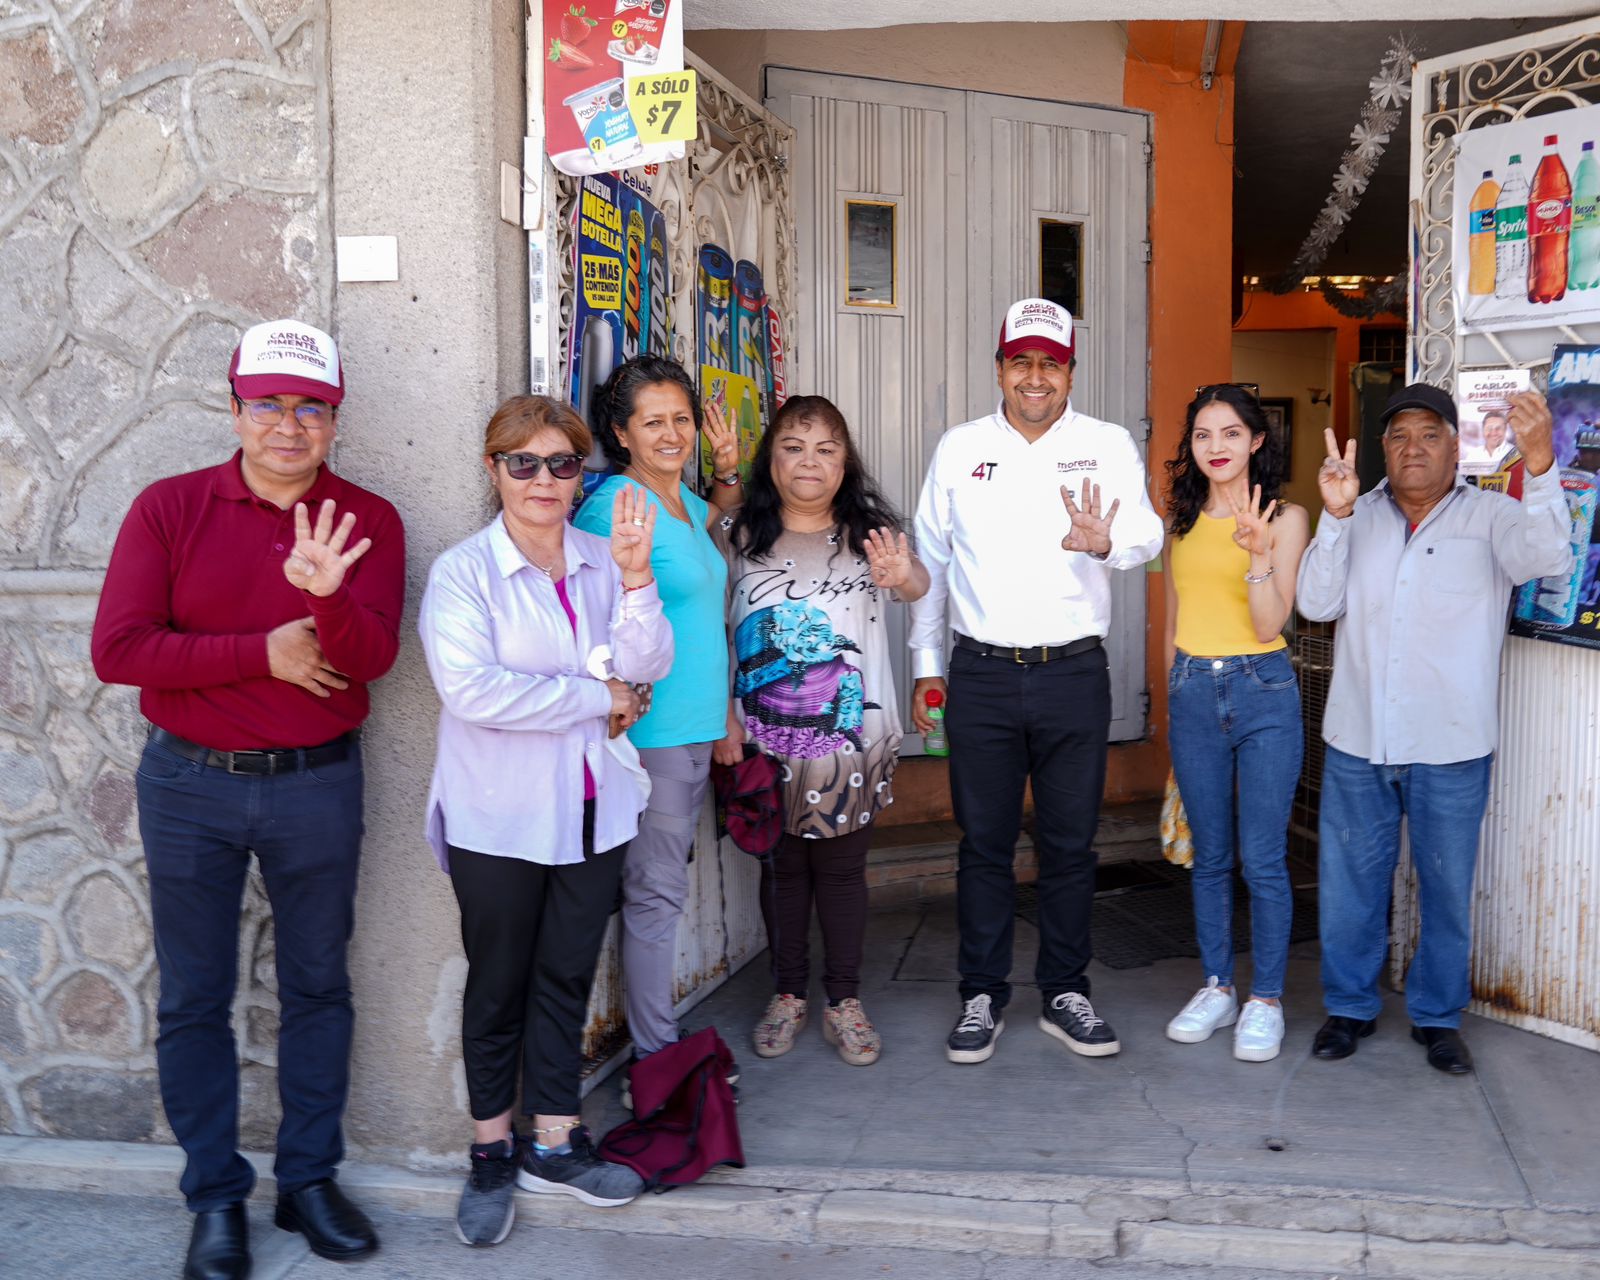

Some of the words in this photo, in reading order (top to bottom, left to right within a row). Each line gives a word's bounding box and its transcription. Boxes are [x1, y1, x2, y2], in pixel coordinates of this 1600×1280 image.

[613, 23, 625, 35] $7
[635, 82, 647, 96] A
[651, 77, 689, 96] SÓLO
[646, 100, 682, 135] $7
[591, 138, 602, 151] $7
[583, 174, 611, 202] NUEVA
[581, 189, 622, 234] MEGA
[581, 217, 622, 253] BOTELLA
[598, 259, 620, 282] MÁS
[585, 280, 620, 294] CONTENIDO
[267, 339, 322, 355] PIMENTEL
[270, 332, 317, 345] CARLOS
[285, 351, 327, 369] morena
[971, 462, 998, 480] 4T
[1057, 459, 1098, 469] morena
